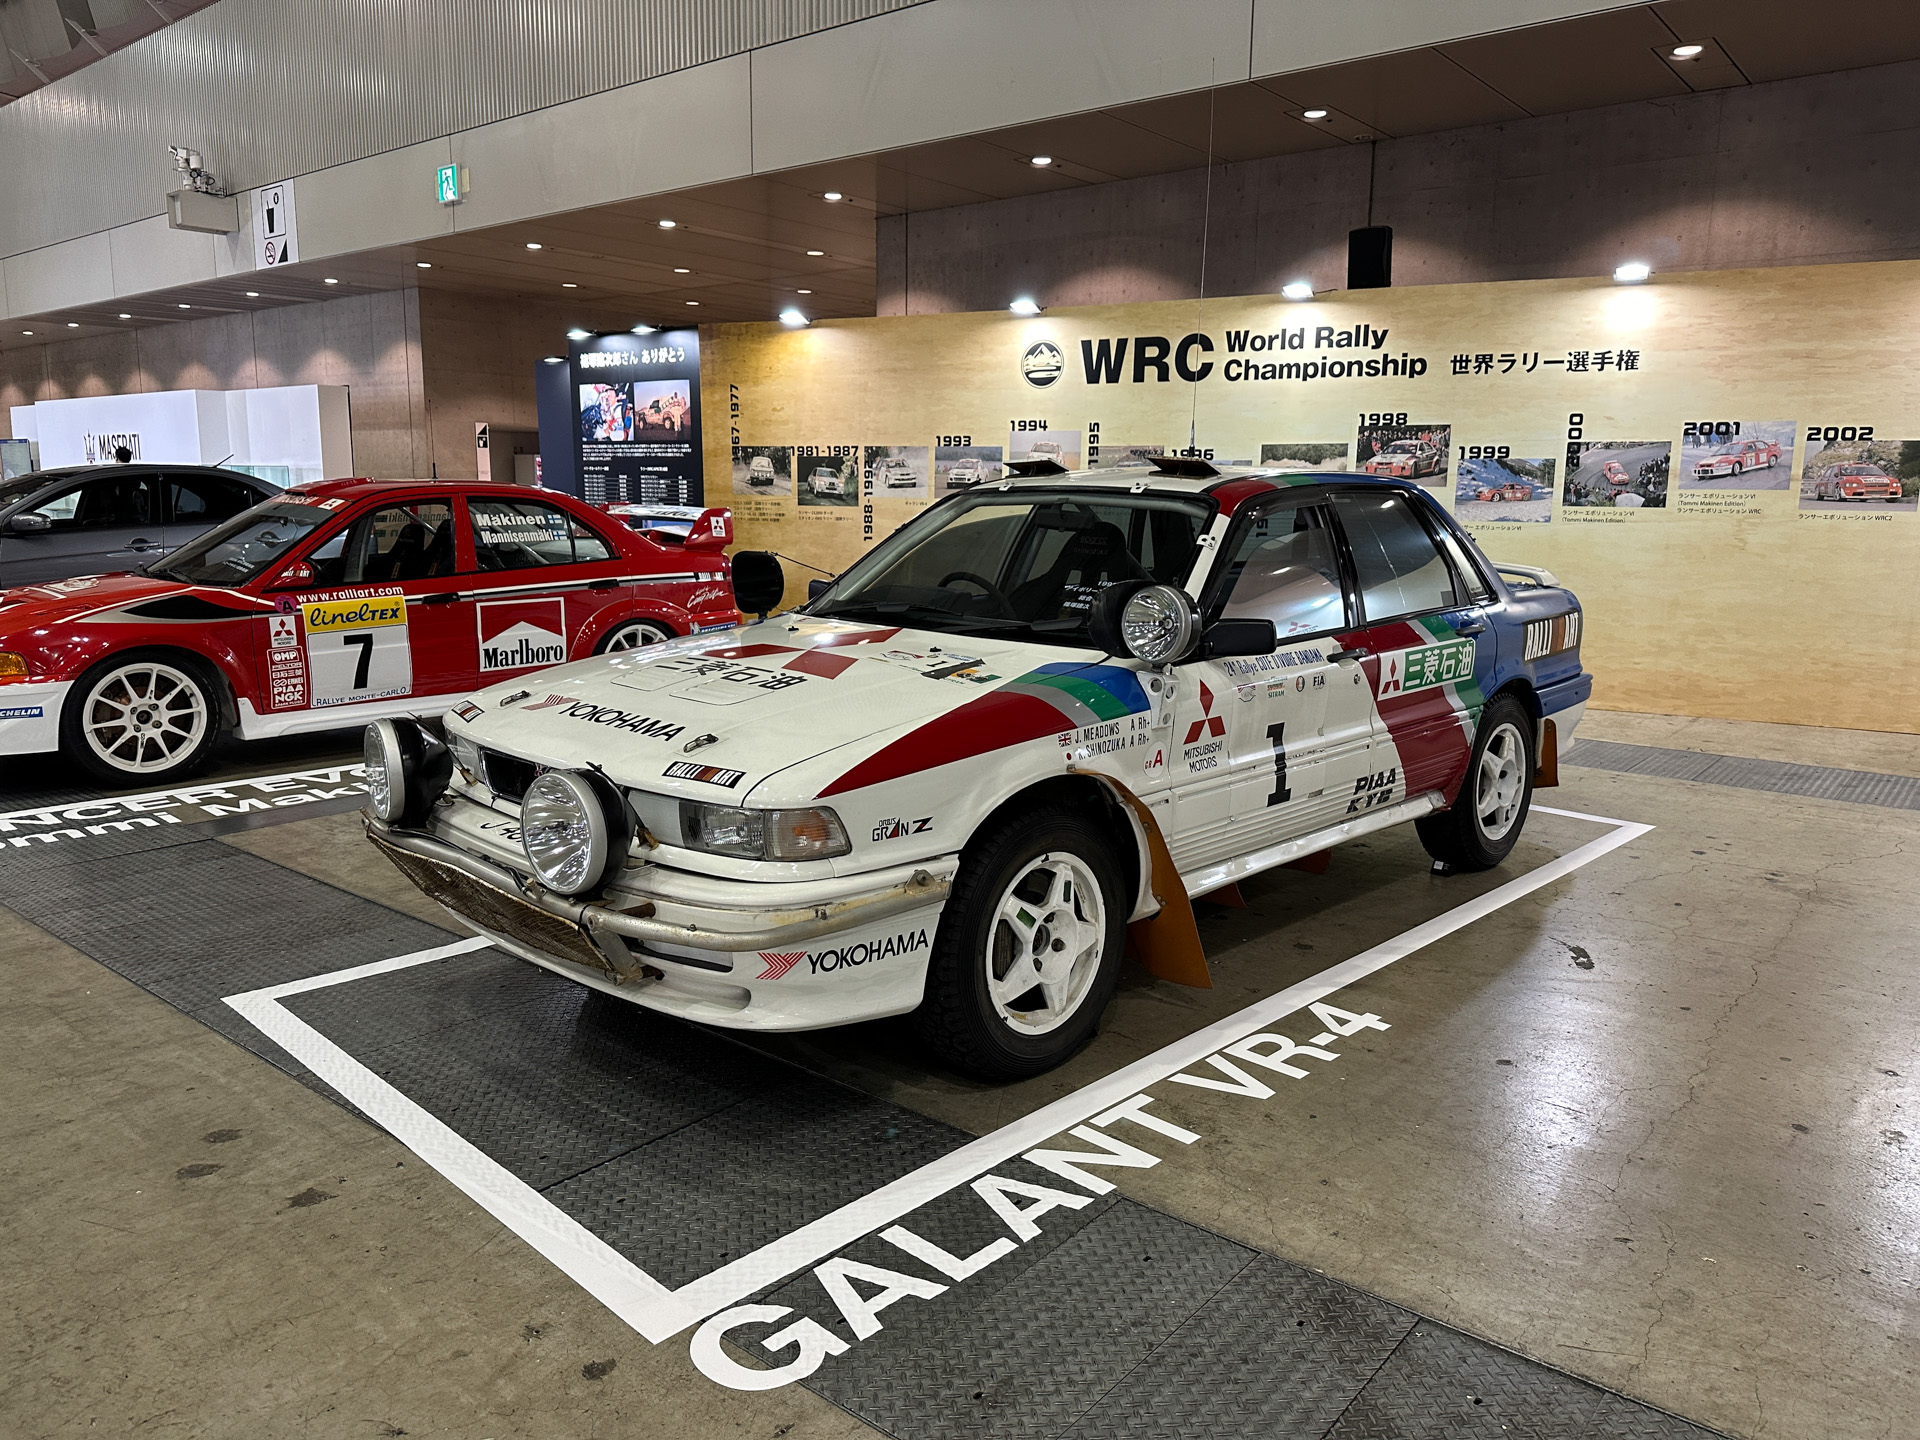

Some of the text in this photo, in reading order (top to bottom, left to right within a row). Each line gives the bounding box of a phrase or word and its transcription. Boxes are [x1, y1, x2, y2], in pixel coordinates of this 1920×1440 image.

[1225, 323, 1389, 352] World Rally
[641, 347, 685, 364] ありがとう
[1080, 333, 1214, 384] WRC
[1450, 350, 1640, 375] 世界ラリー選手権
[1223, 352, 1428, 382] Championship
[1010, 420, 1048, 432] 1994
[1359, 413, 1408, 427] 1998
[1683, 421, 1742, 437] 2001
[936, 436, 972, 447] 1993
[1088, 422, 1100, 465] 1995
[1806, 426, 1875, 442] 2002
[791, 446, 859, 457] 1981-1987
[1458, 446, 1510, 460] 1999
[863, 460, 874, 541] 1988-1992
[475, 513, 547, 527] Mäkinen
[1874, 514, 1893, 522] WRC2
[480, 528, 554, 544] Mannisenmäki
[296, 586, 404, 603] www.ralliart.com
[273, 651, 297, 661] OMP
[343, 633, 374, 690] 7
[482, 638, 564, 669] Marlboro
[1404, 642, 1474, 687] 三菱石油
[273, 685, 304, 695] PIAA
[275, 692, 303, 704] NGK
[316, 686, 407, 706] RALLYE MONTE-CARLO
[558, 701, 687, 742] YOKOHAMA
[1074, 734, 1082, 744] J.
[1083, 721, 1120, 741] MEADOWS
[1130, 718, 1135, 732] A
[1129, 735, 1135, 748] A
[1183, 740, 1223, 760] MITSUBISHI
[1153, 749, 1163, 768] A
[1188, 755, 1218, 773] MOTORS
[1266, 721, 1292, 807] 1
[249, 768, 367, 795] EV
[1353, 767, 1397, 796] PIAA
[0, 811, 183, 850] mmi
[806, 928, 929, 975] YOKOHAMA
[689, 1000, 1393, 1391] GALANT VR-4
